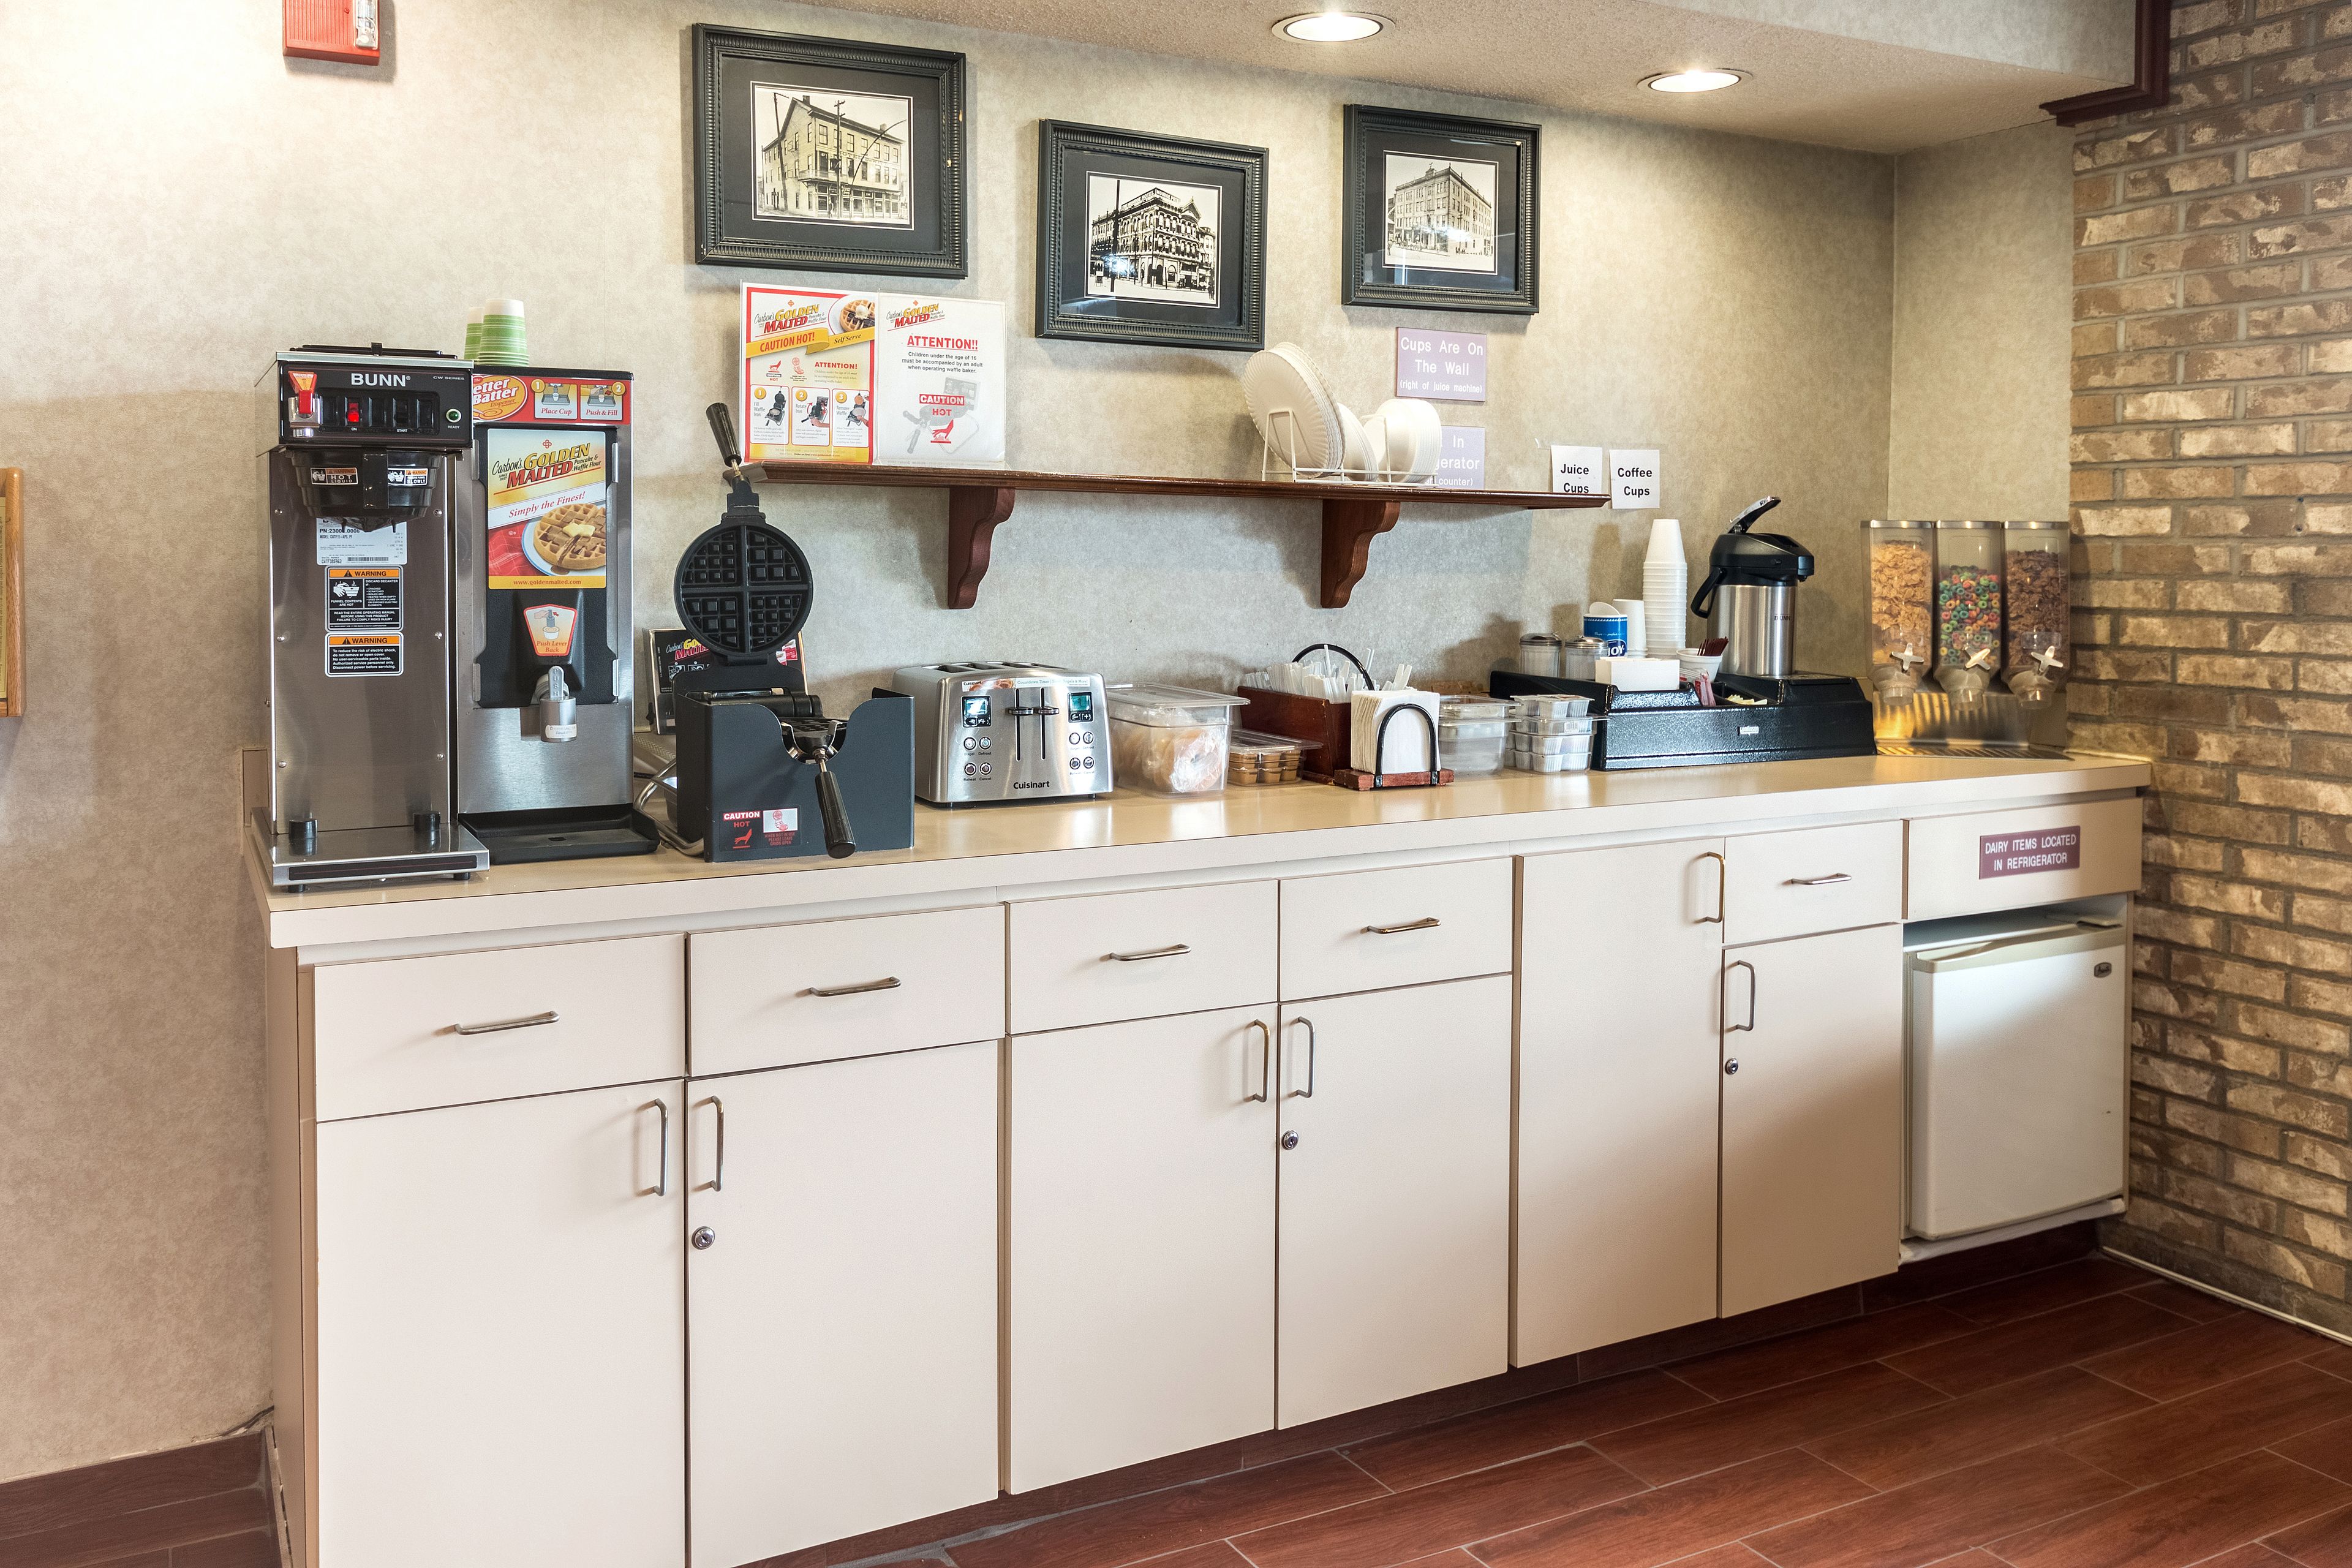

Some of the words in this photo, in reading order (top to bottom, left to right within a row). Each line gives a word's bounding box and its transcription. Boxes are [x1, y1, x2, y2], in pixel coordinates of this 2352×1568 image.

[775, 304, 820, 322] GOLDEN
[903, 303, 939, 318] GOLDEN
[764, 315, 808, 333] MALTED
[894, 313, 930, 328] MALTED
[760, 336, 794, 352] CAUTION
[797, 332, 815, 344] HOT!
[907, 335, 978, 350] ATTENTION!!
[1401, 337, 1431, 354] Cups
[1439, 340, 1460, 354] Are
[1468, 342, 1483, 355] On
[1415, 359, 1437, 374] The
[1445, 361, 1469, 375] Wall
[351, 373, 406, 387] BUNN
[473, 377, 510, 394] etter
[1400, 380, 1418, 390] (right
[1422, 382, 1429, 390] of
[1433, 382, 1449, 391] juice
[1453, 385, 1482, 393] machine)
[473, 386, 519, 405] Batter
[490, 398, 515, 408] Dispenser
[920, 395, 963, 404] CAUTION
[1453, 435, 1464, 448] In
[492, 458, 523, 476] Carbon's
[523, 443, 590, 470] GOLDEN
[573, 462, 588, 472] Waffle
[574, 456, 594, 466] Pancake
[1435, 457, 1480, 470] gerator
[507, 461, 573, 488] MALTED
[1561, 464, 1589, 475] Juice
[1618, 467, 1653, 478] Coffee
[1563, 483, 1589, 494] Cups
[1624, 486, 1650, 498] Cups
[509, 505, 540, 518] Simply
[541, 500, 554, 510] the
[556, 491, 586, 505] Finest!
[675, 644, 709, 660] MALTE
[1013, 780, 1050, 790] Cuisinart
[1985, 841, 2009, 854] DAIRY
[2012, 838, 2037, 851] ITEMS
[2041, 834, 2076, 848] LOCATED
[1994, 859, 2002, 871] IN
[2007, 853, 2067, 869] REFRIGERATOR
